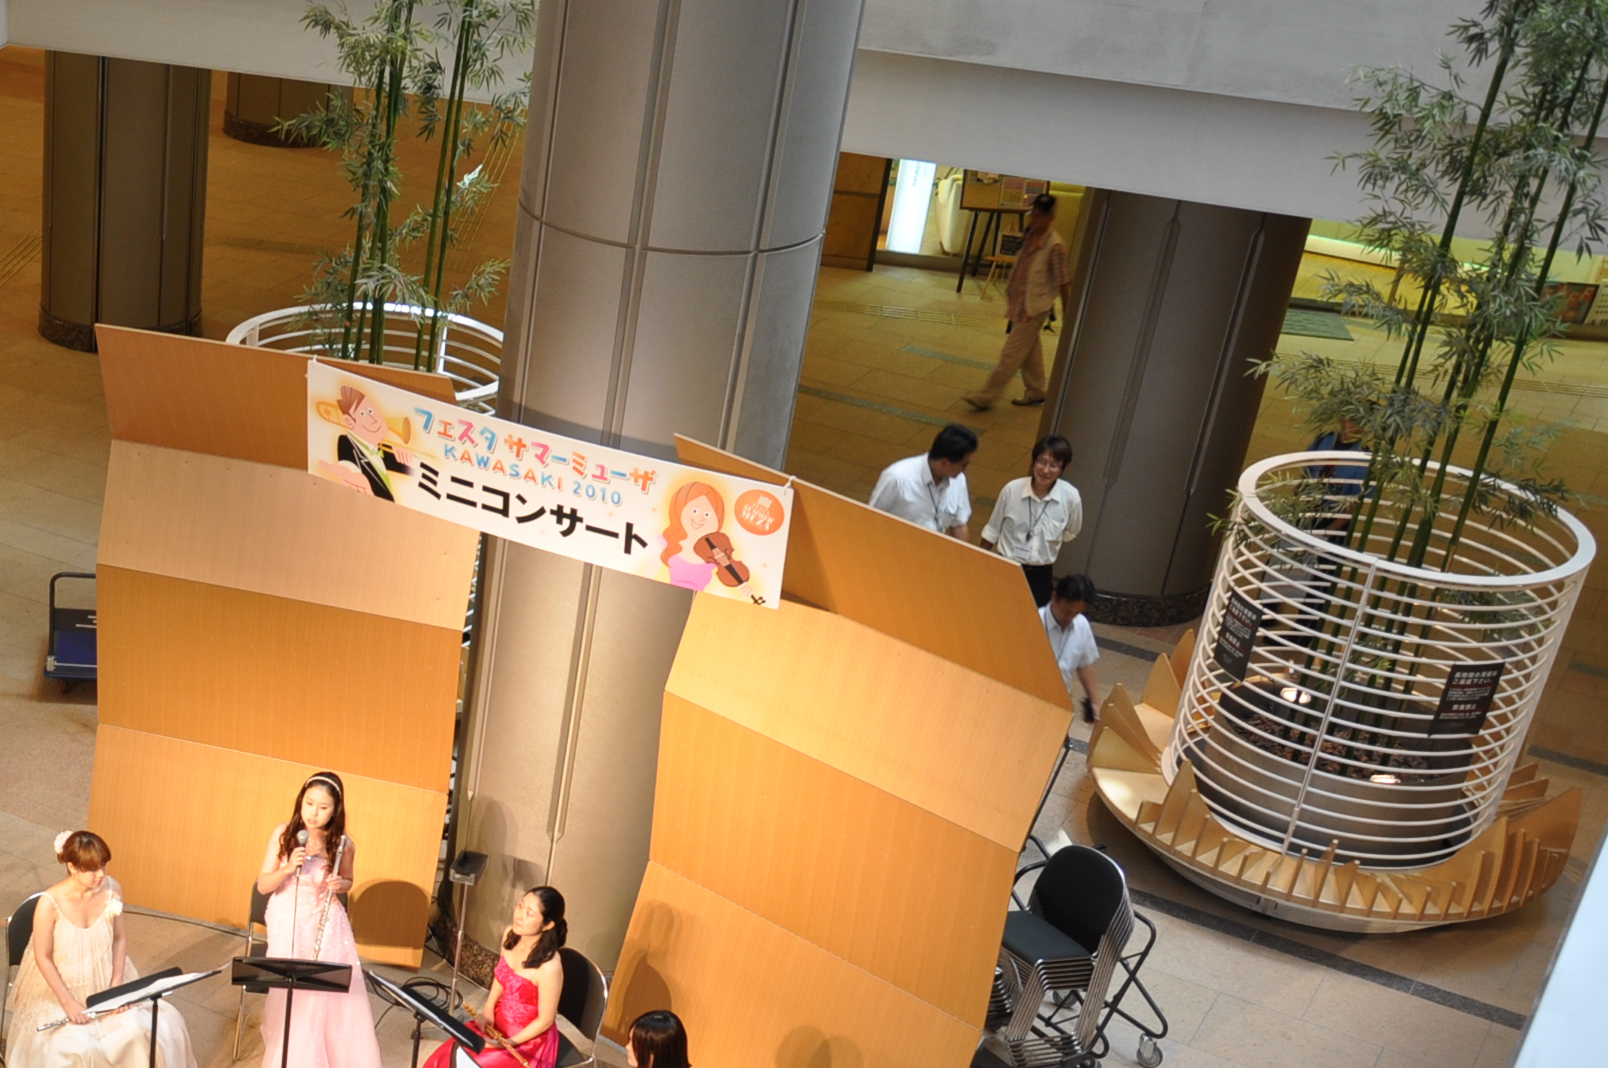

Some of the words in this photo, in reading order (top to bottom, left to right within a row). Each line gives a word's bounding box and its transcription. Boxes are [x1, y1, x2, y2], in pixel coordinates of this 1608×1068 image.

[417, 461, 649, 556] ミニコンサート
[443, 443, 564, 491] KAWASAKI
[572, 480, 623, 507] 2010
